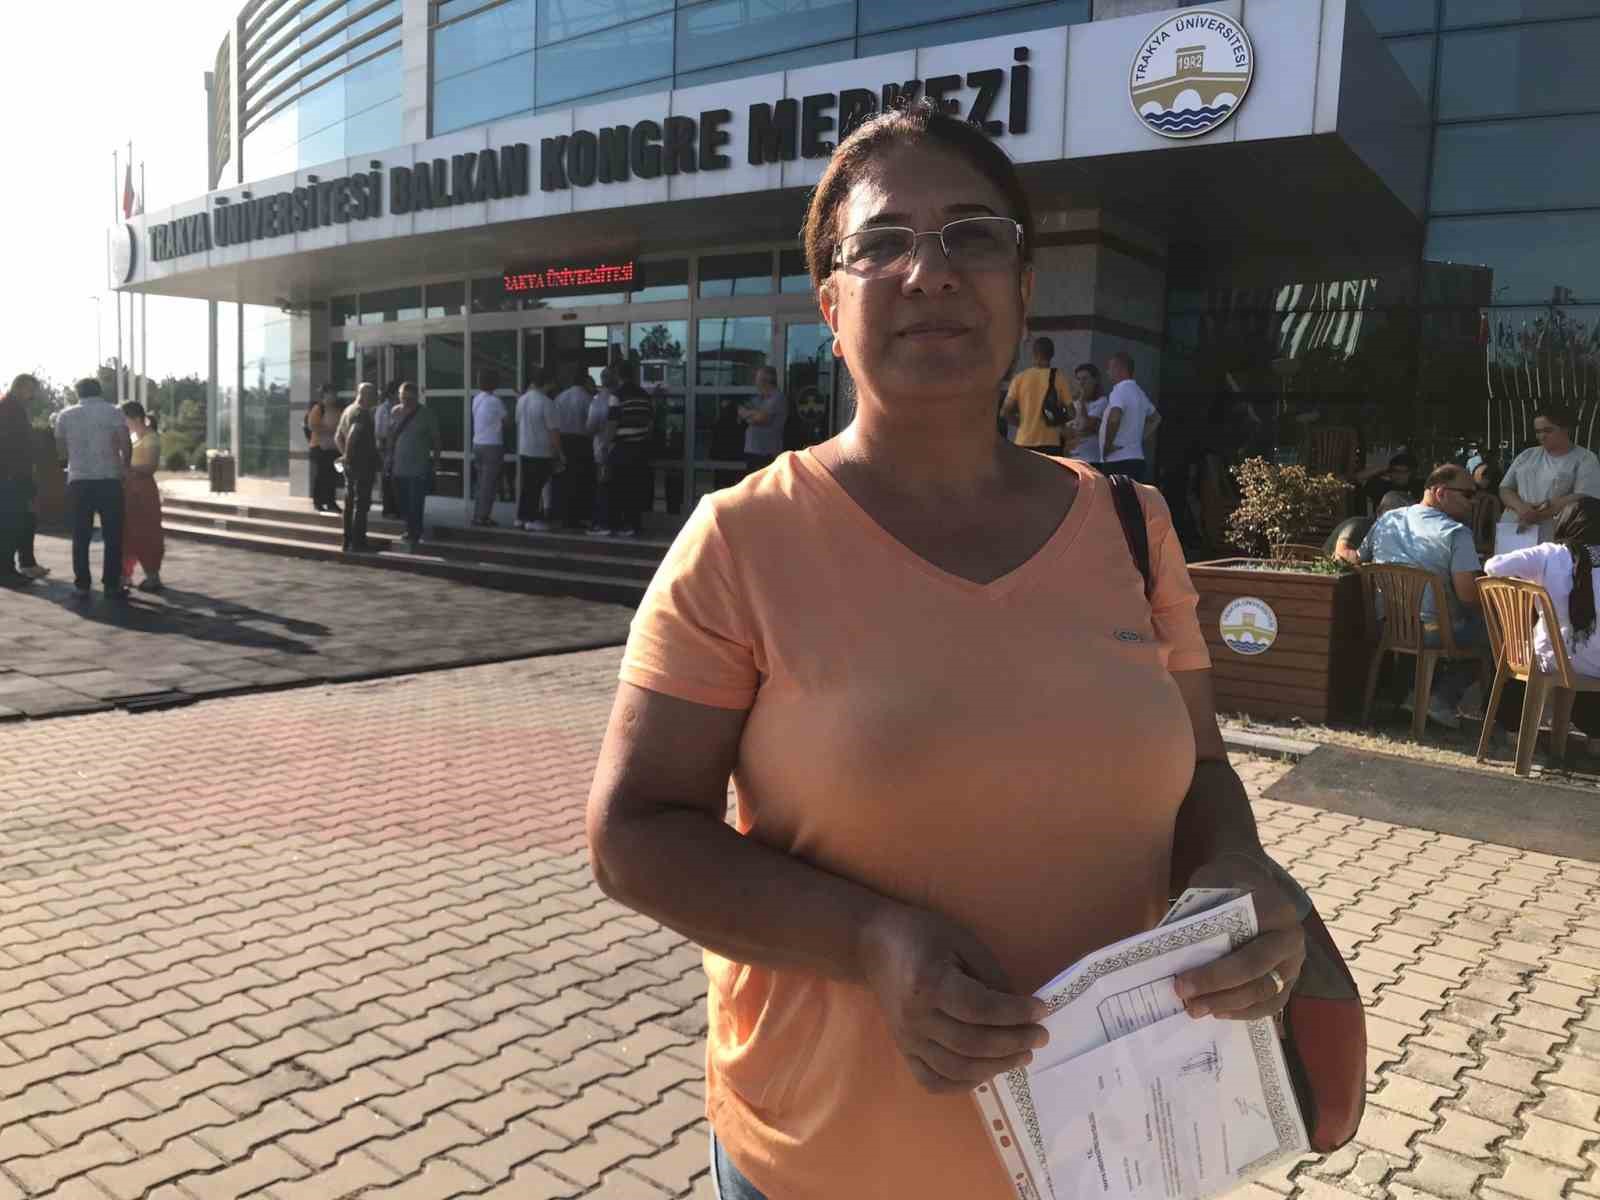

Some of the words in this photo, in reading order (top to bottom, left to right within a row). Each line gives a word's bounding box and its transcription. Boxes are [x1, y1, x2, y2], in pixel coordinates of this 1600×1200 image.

[1135, 31, 1171, 82] TRAKYA
[1175, 15, 1248, 68] ÜNİVERSİTESİ
[148, 212, 213, 262] TRAKYA
[213, 159, 383, 247] ÜNİVERSİTESİ
[389, 142, 529, 215] BALKAN
[540, 108, 732, 192] KONGRE
